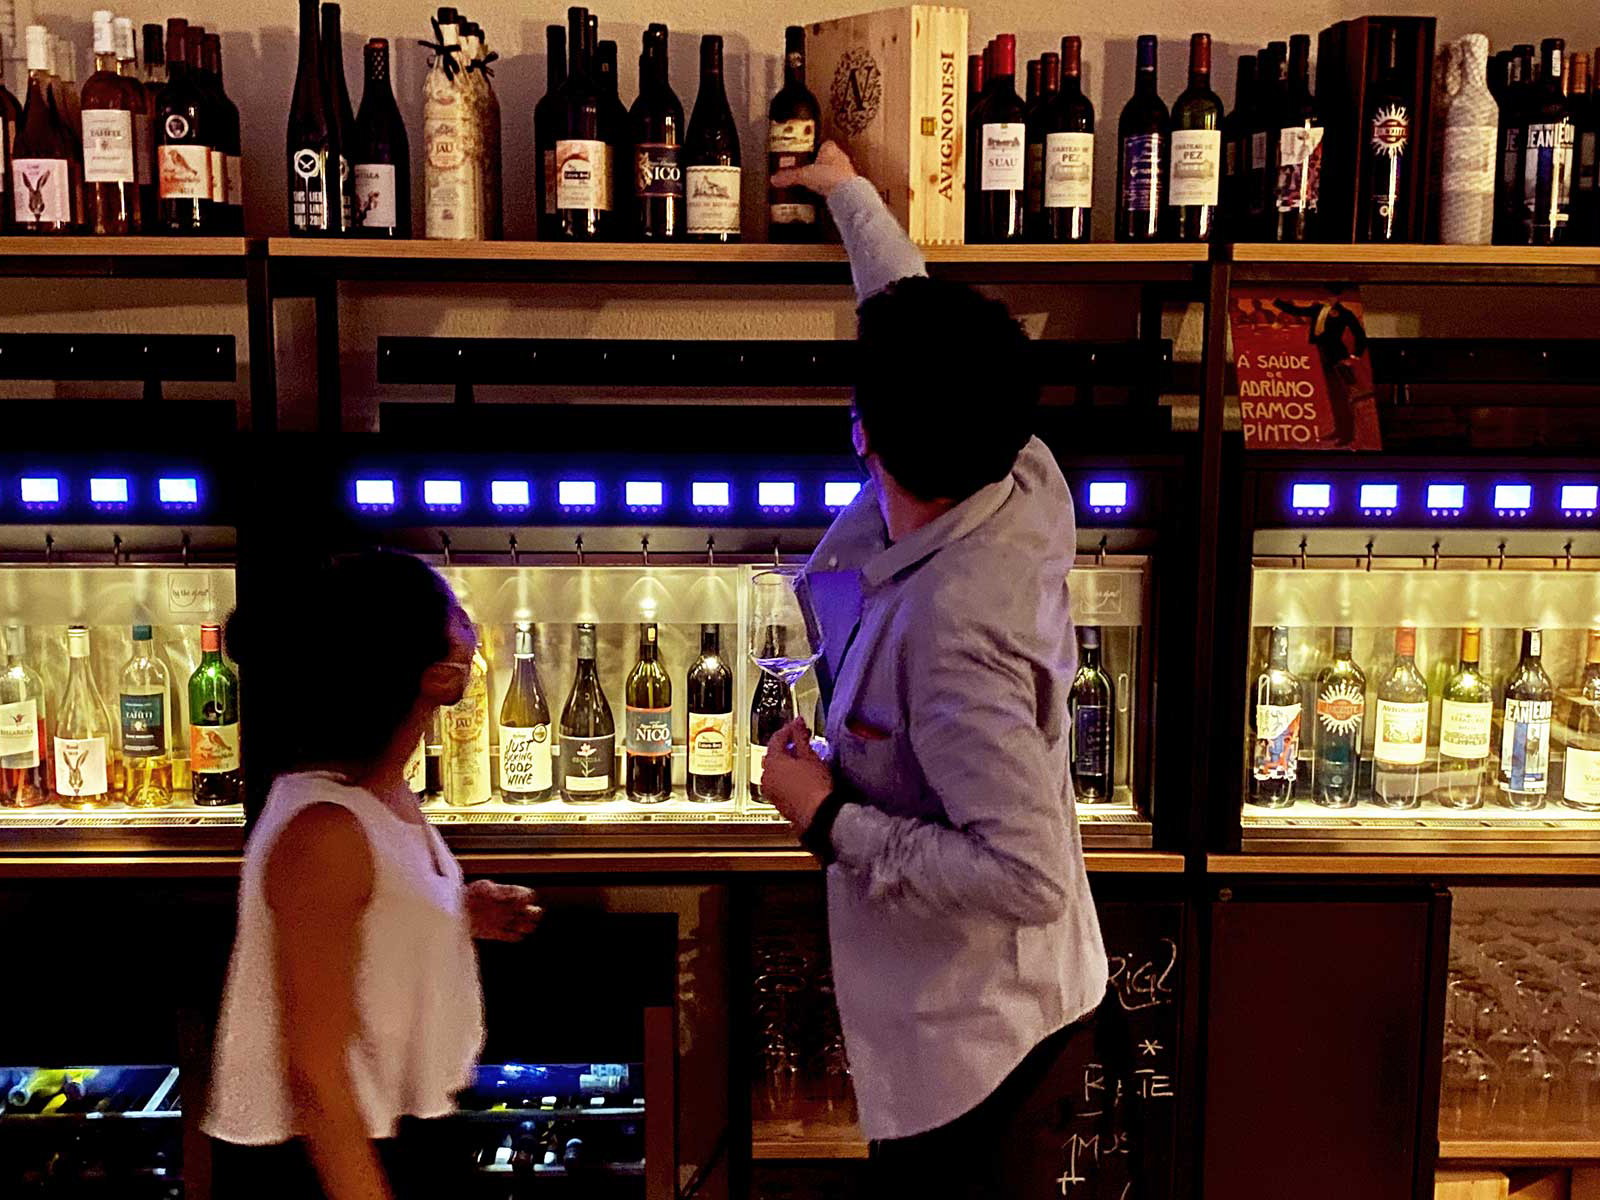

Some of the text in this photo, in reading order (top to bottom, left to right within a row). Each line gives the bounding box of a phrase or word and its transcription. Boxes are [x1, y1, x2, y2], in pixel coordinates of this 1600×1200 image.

[939, 51, 955, 204] AVIGNONESI
[1183, 151, 1203, 160] PEZ
[988, 158, 1019, 168] SUAU
[1240, 379, 1315, 397] ADRIANO
[1243, 402, 1317, 420] RAMOS
[454, 717, 472, 730] JAU
[635, 728, 671, 742] NICO
[505, 739, 534, 753] JUST
[504, 762, 533, 773] GOOD
[507, 773, 533, 785] WINE
